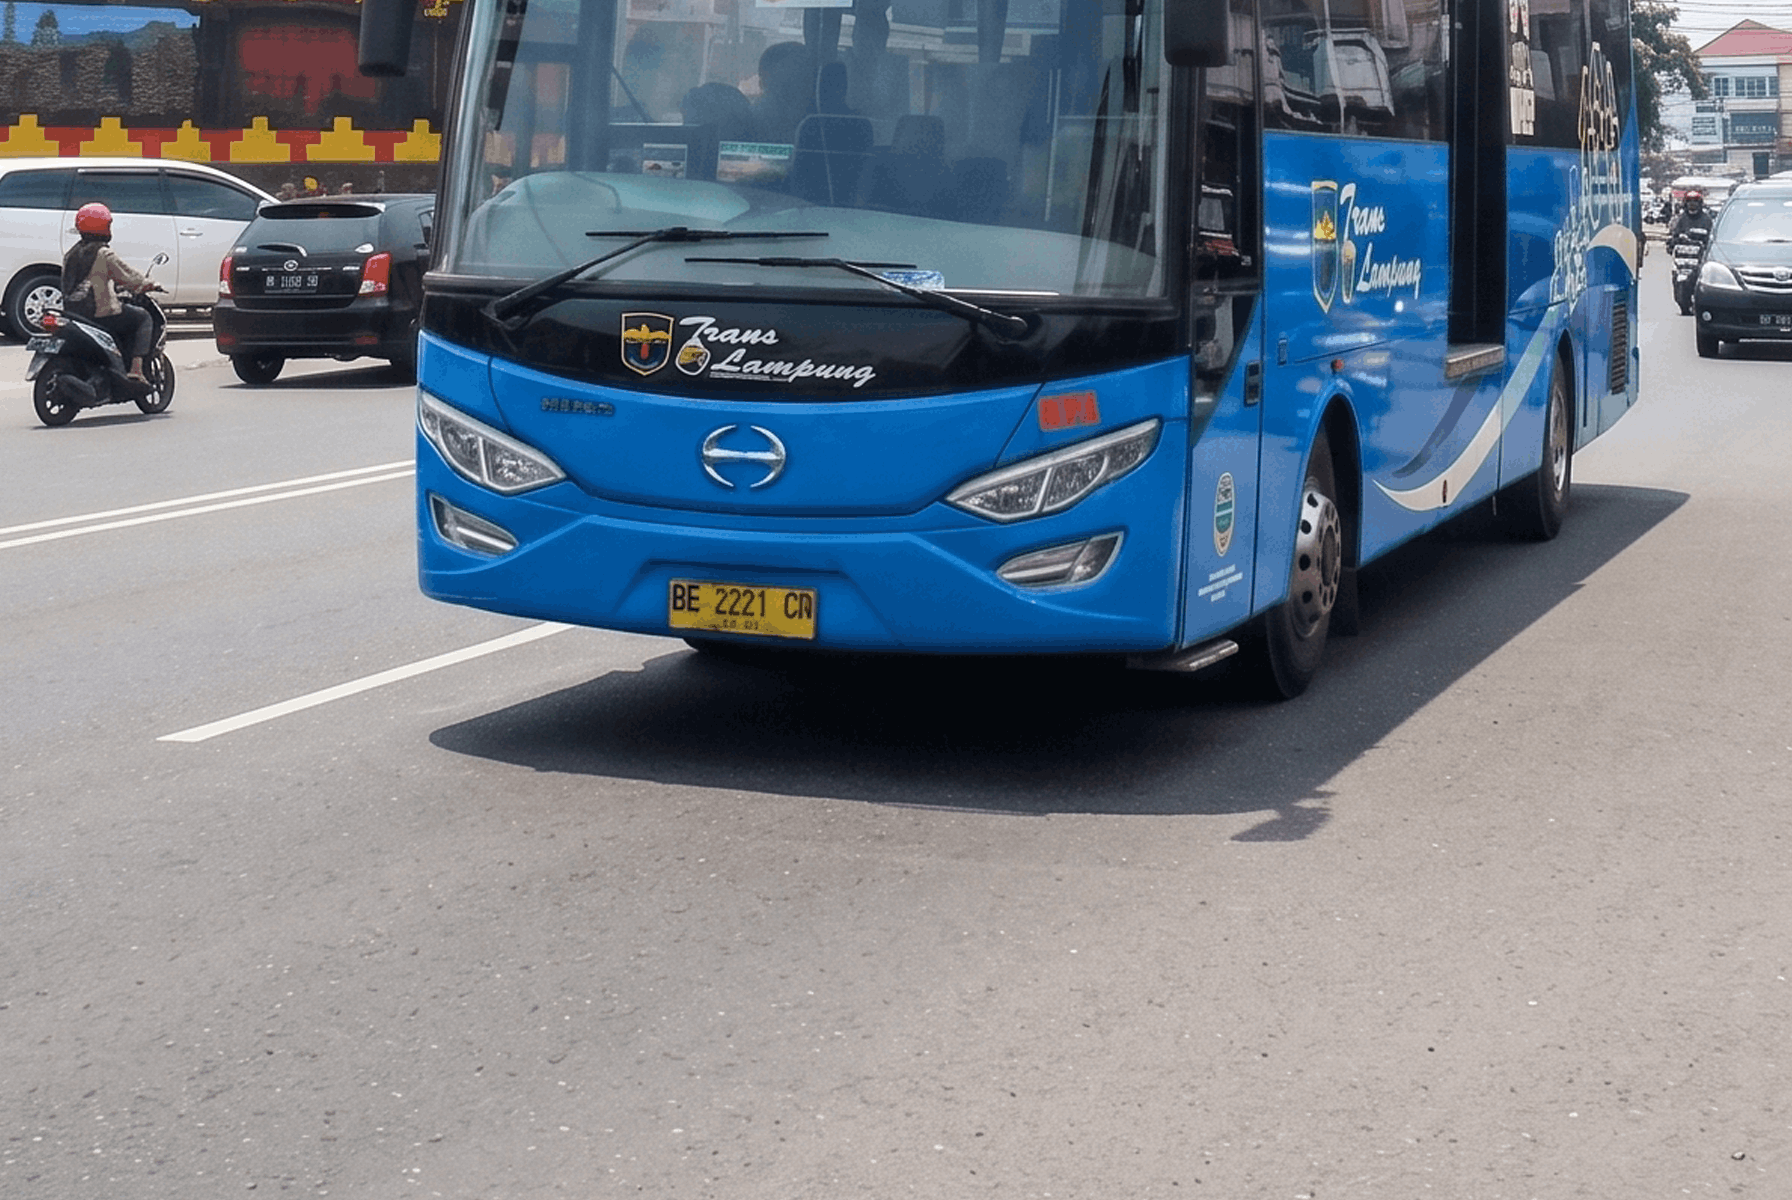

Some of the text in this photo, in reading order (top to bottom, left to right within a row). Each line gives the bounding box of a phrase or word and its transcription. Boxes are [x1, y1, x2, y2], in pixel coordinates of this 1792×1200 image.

[679, 316, 779, 345] Trans
[710, 348, 876, 388] Lampung
[672, 583, 700, 613] BE
[715, 588, 766, 618] 2221
